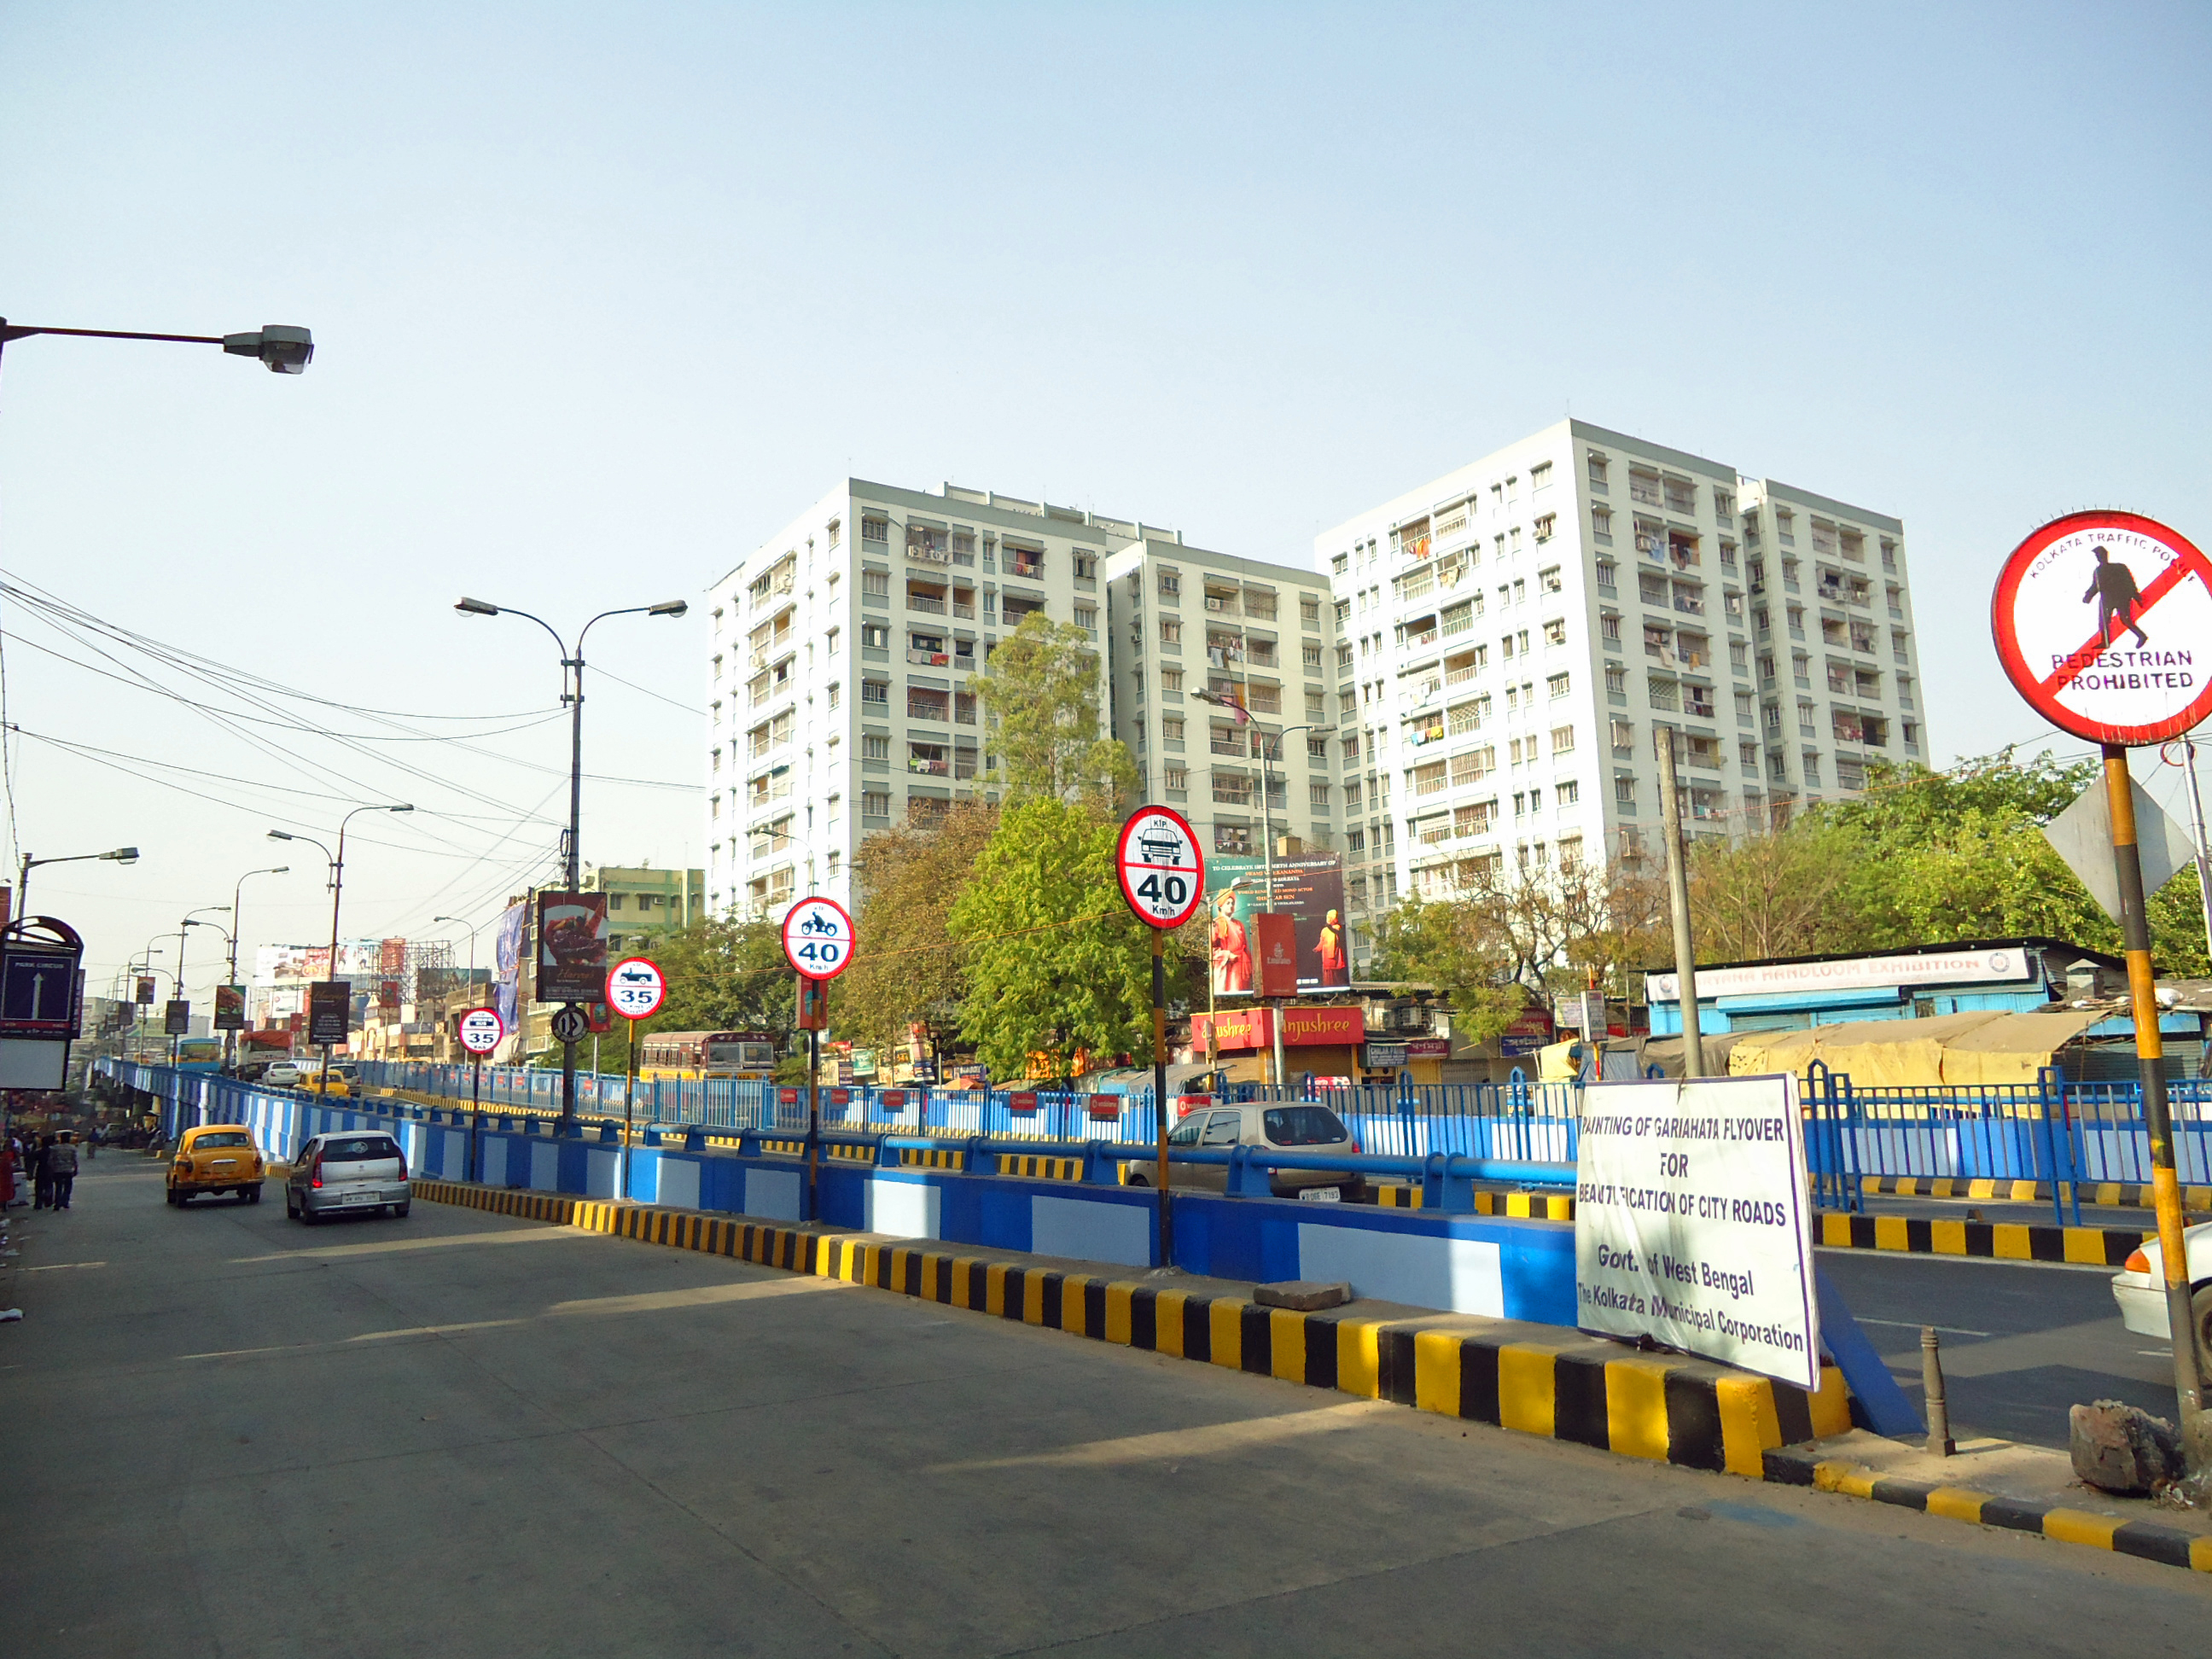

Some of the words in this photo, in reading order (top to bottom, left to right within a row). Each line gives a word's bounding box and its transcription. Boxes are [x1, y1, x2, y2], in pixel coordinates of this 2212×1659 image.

[2030, 538, 2082, 579] KOLKATA
[2088, 533, 2146, 550] TRAFFIC
[2052, 650, 2192, 670] PEDESTRIAN
[2057, 672, 2193, 690] PROHIBITED
[1289, 860, 1328, 869] ANNIVERSARY
[1138, 874, 1186, 905] 40
[799, 942, 839, 963] 40
[1762, 962, 1861, 981] HANDLOOM
[1868, 959, 1980, 974] EXHIBITION
[620, 990, 652, 1004] 35
[469, 1033, 494, 1044] 35
[1581, 1115, 1633, 1136] PAINTING
[1636, 1116, 1653, 1137] OF
[1654, 1117, 1720, 1141] GARIAHATA
[1724, 1118, 1784, 1142] FLYOVER
[1660, 1152, 1689, 1178] FOR
[1679, 1192, 1695, 1216] OF
[1698, 1196, 1729, 1220] CITY
[1732, 1199, 1786, 1227] ROADS
[1598, 1243, 1639, 1272] Govt.
[1647, 1253, 1659, 1277] of
[1662, 1254, 1698, 1285] West
[1701, 1262, 1755, 1300] Bengal
[1578, 1282, 1592, 1305] The
[1593, 1285, 1645, 1315] Kolkata
[1650, 1295, 1715, 1333] Municipal
[1717, 1311, 1804, 1352] Corporation
